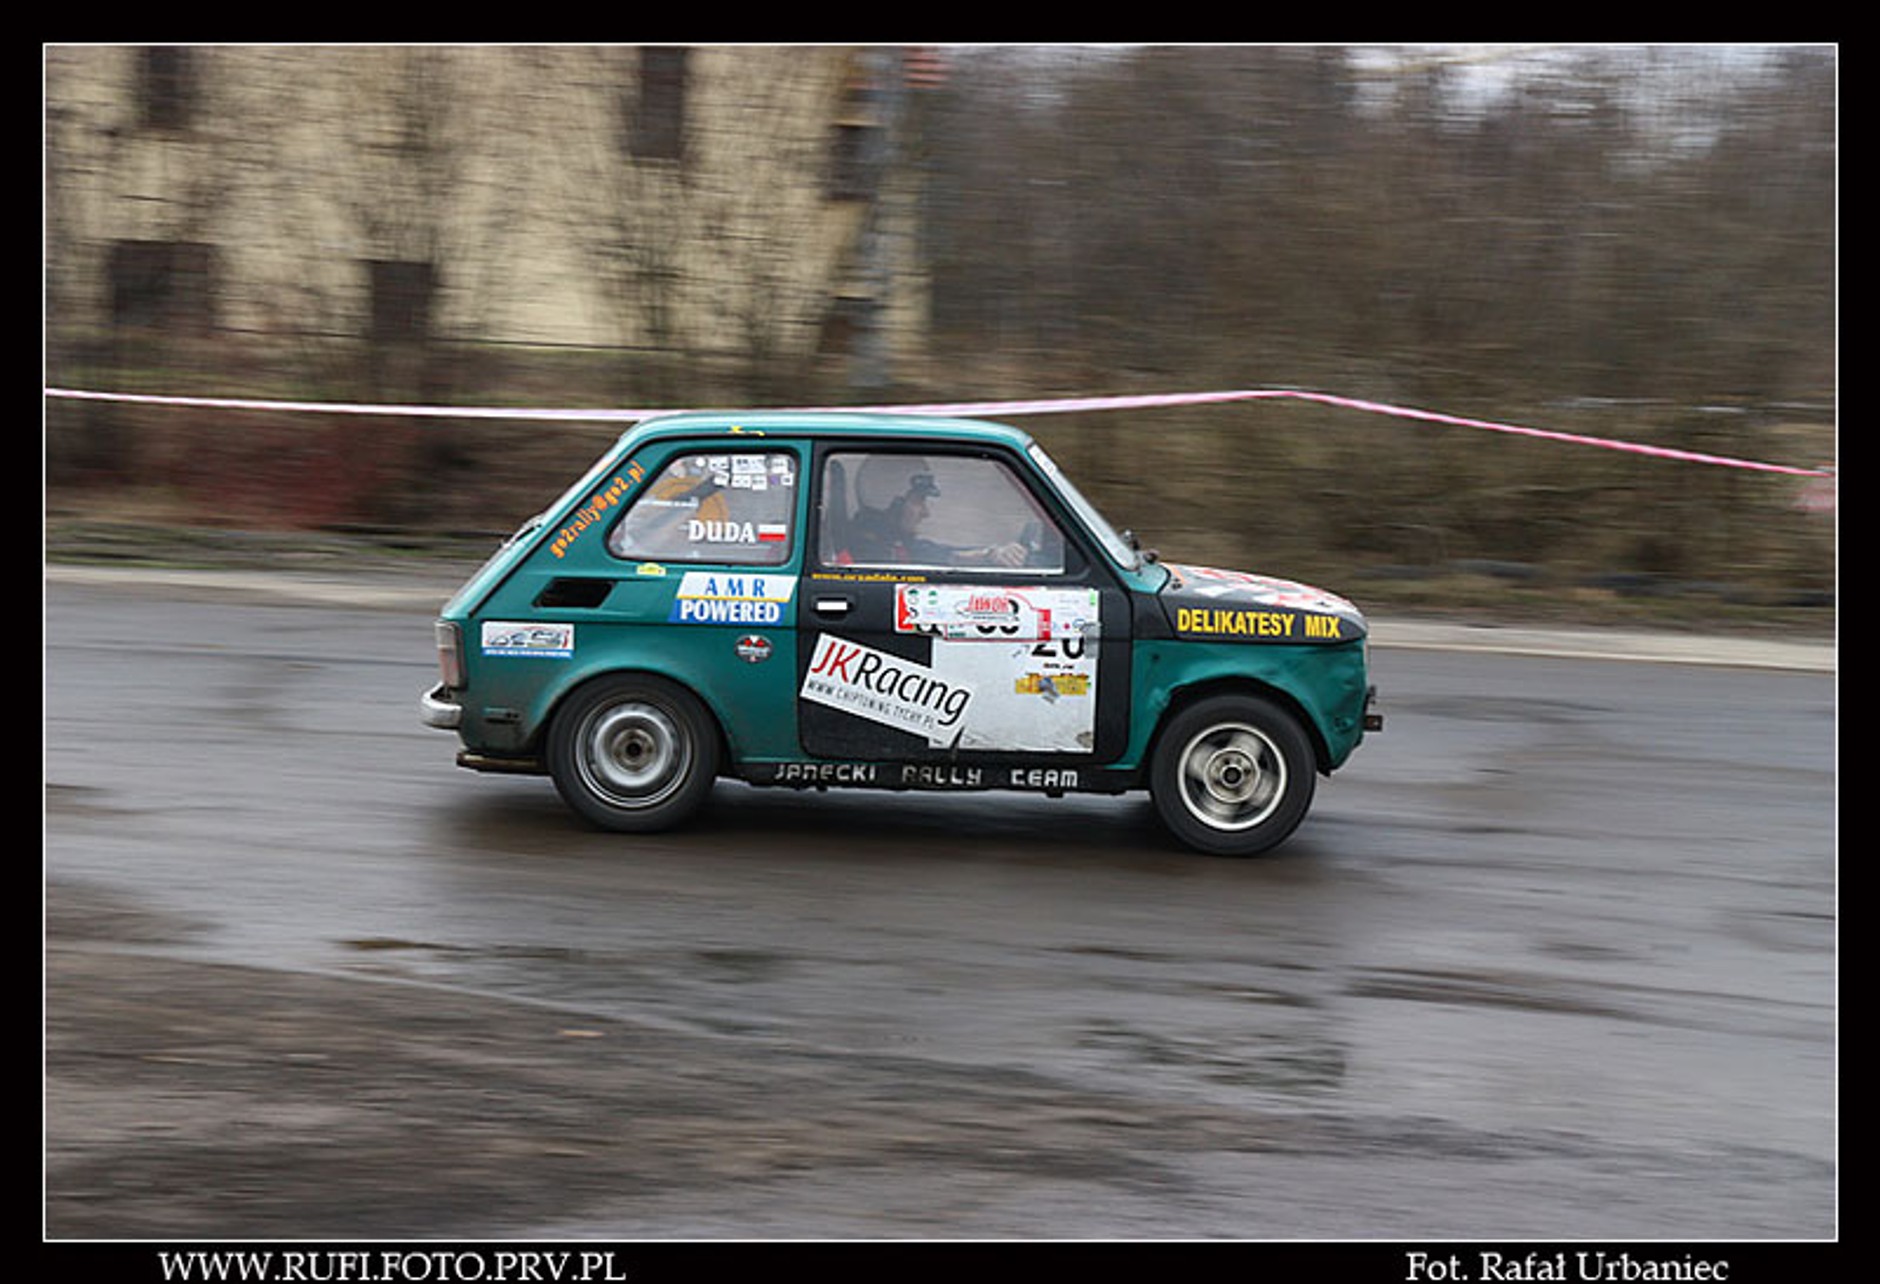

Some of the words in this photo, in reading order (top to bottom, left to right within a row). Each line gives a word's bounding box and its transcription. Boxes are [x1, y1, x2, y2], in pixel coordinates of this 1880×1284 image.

[688, 519, 756, 543] DUDA
[680, 600, 781, 623] POWERED
[1177, 608, 1295, 637] DELIKATESY
[1304, 614, 1341, 639] MIX
